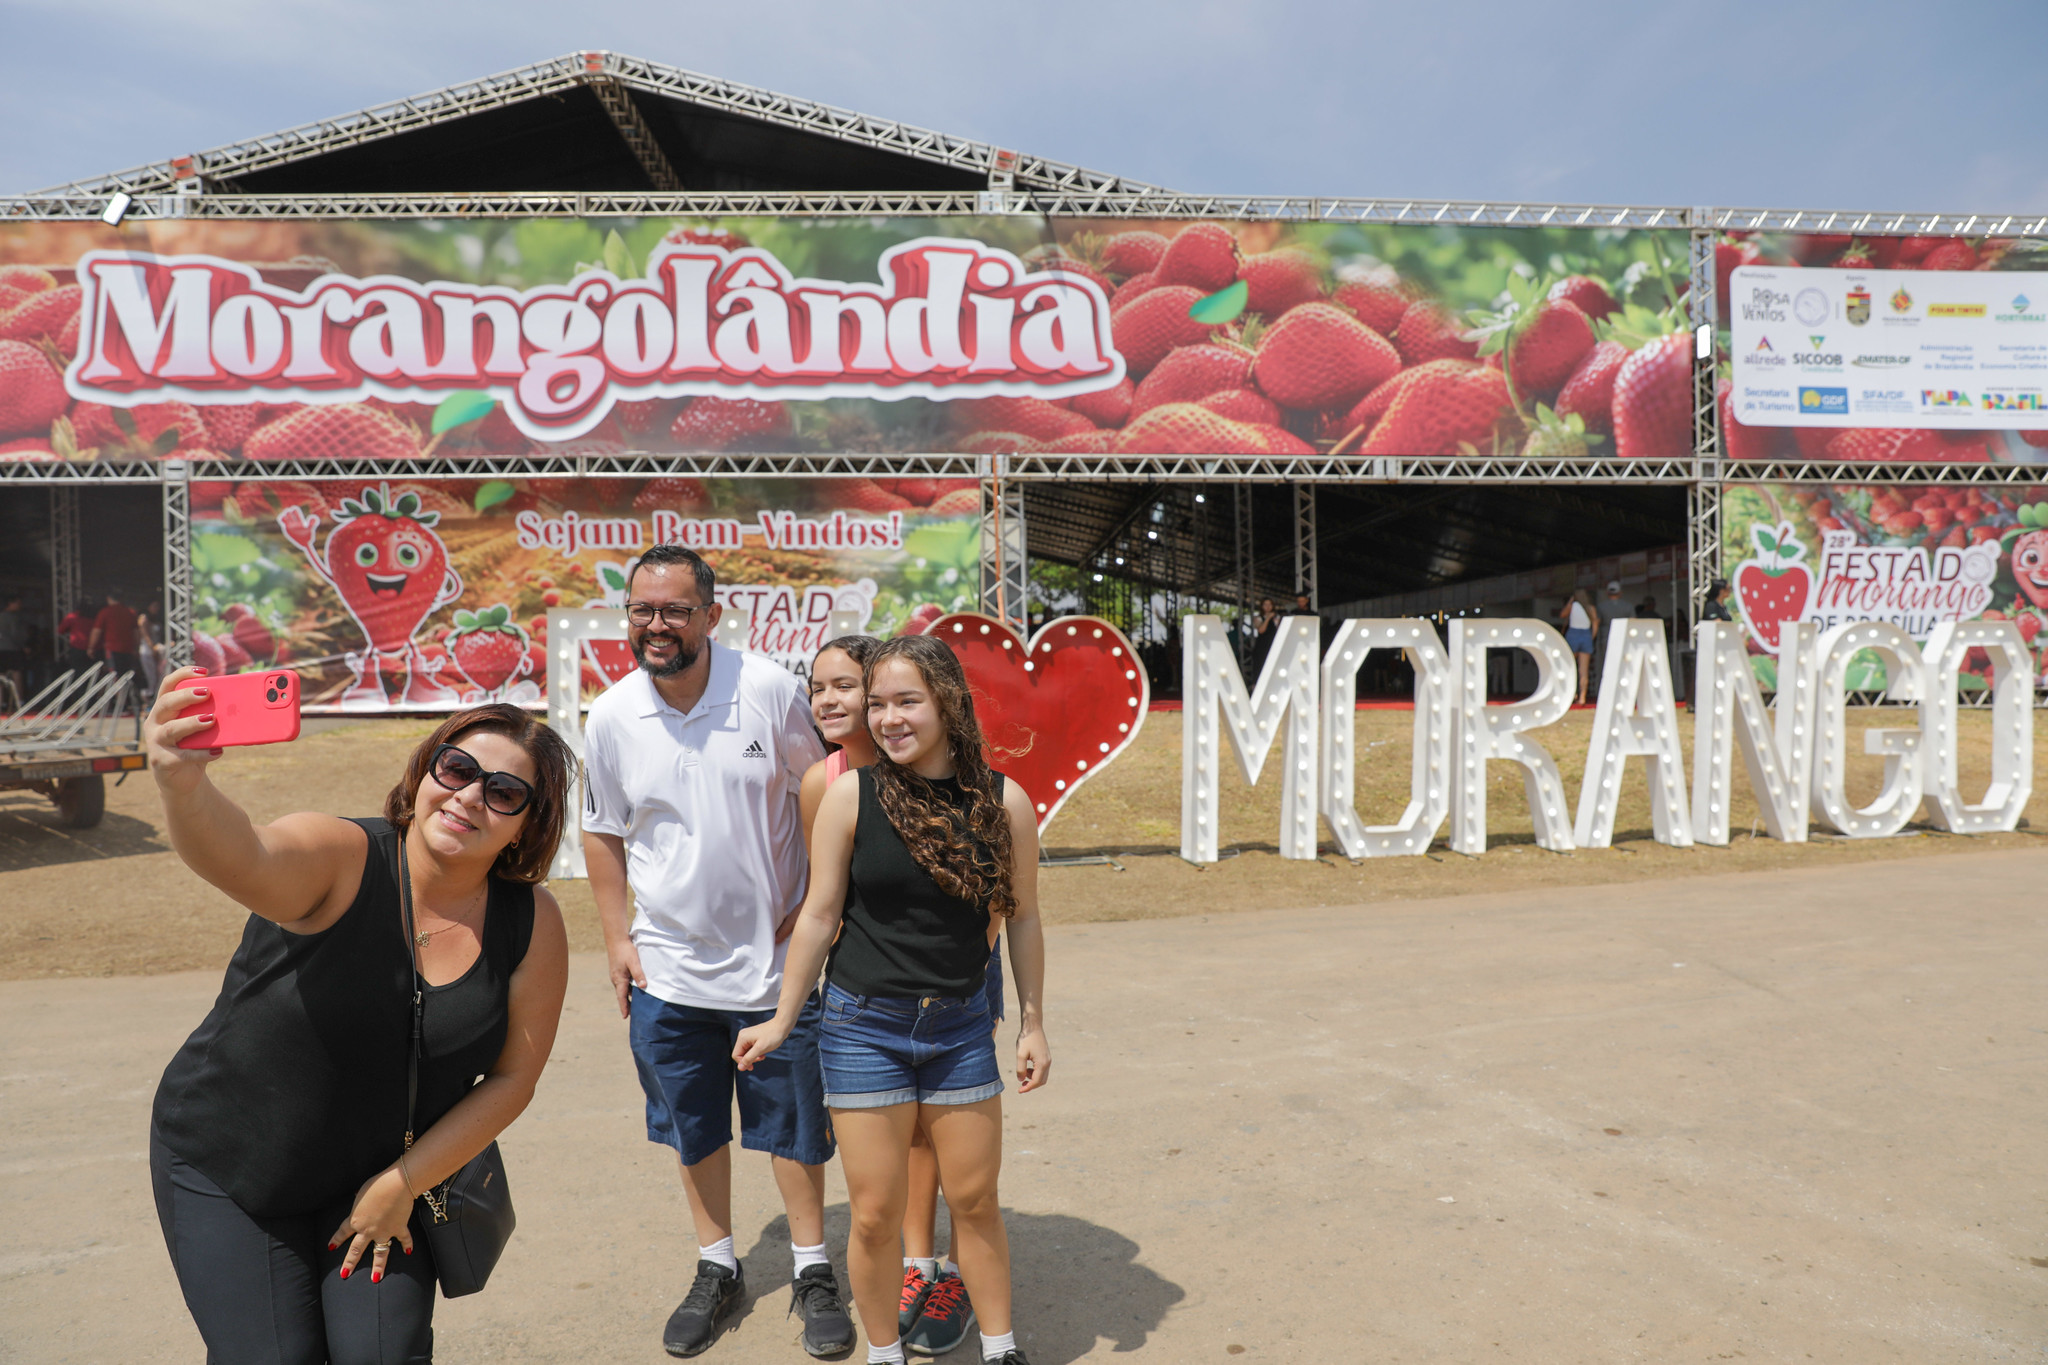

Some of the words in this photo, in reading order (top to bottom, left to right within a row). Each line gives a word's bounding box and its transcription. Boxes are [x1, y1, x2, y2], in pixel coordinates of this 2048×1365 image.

[76, 243, 1118, 430] Morangolândia
[1744, 354, 1786, 366] allrede
[1793, 353, 1843, 365] SICOOB
[1744, 388, 1789, 397] Secretaria
[1759, 402, 1795, 412] Turismo
[1981, 394, 2048, 410] BRASIL
[516, 512, 642, 556] Sejam
[654, 512, 901, 548] Bem-Vindos!
[1825, 553, 1926, 582] FESTA
[1181, 613, 2034, 863] MORANGO
[742, 751, 767, 759] adidas
